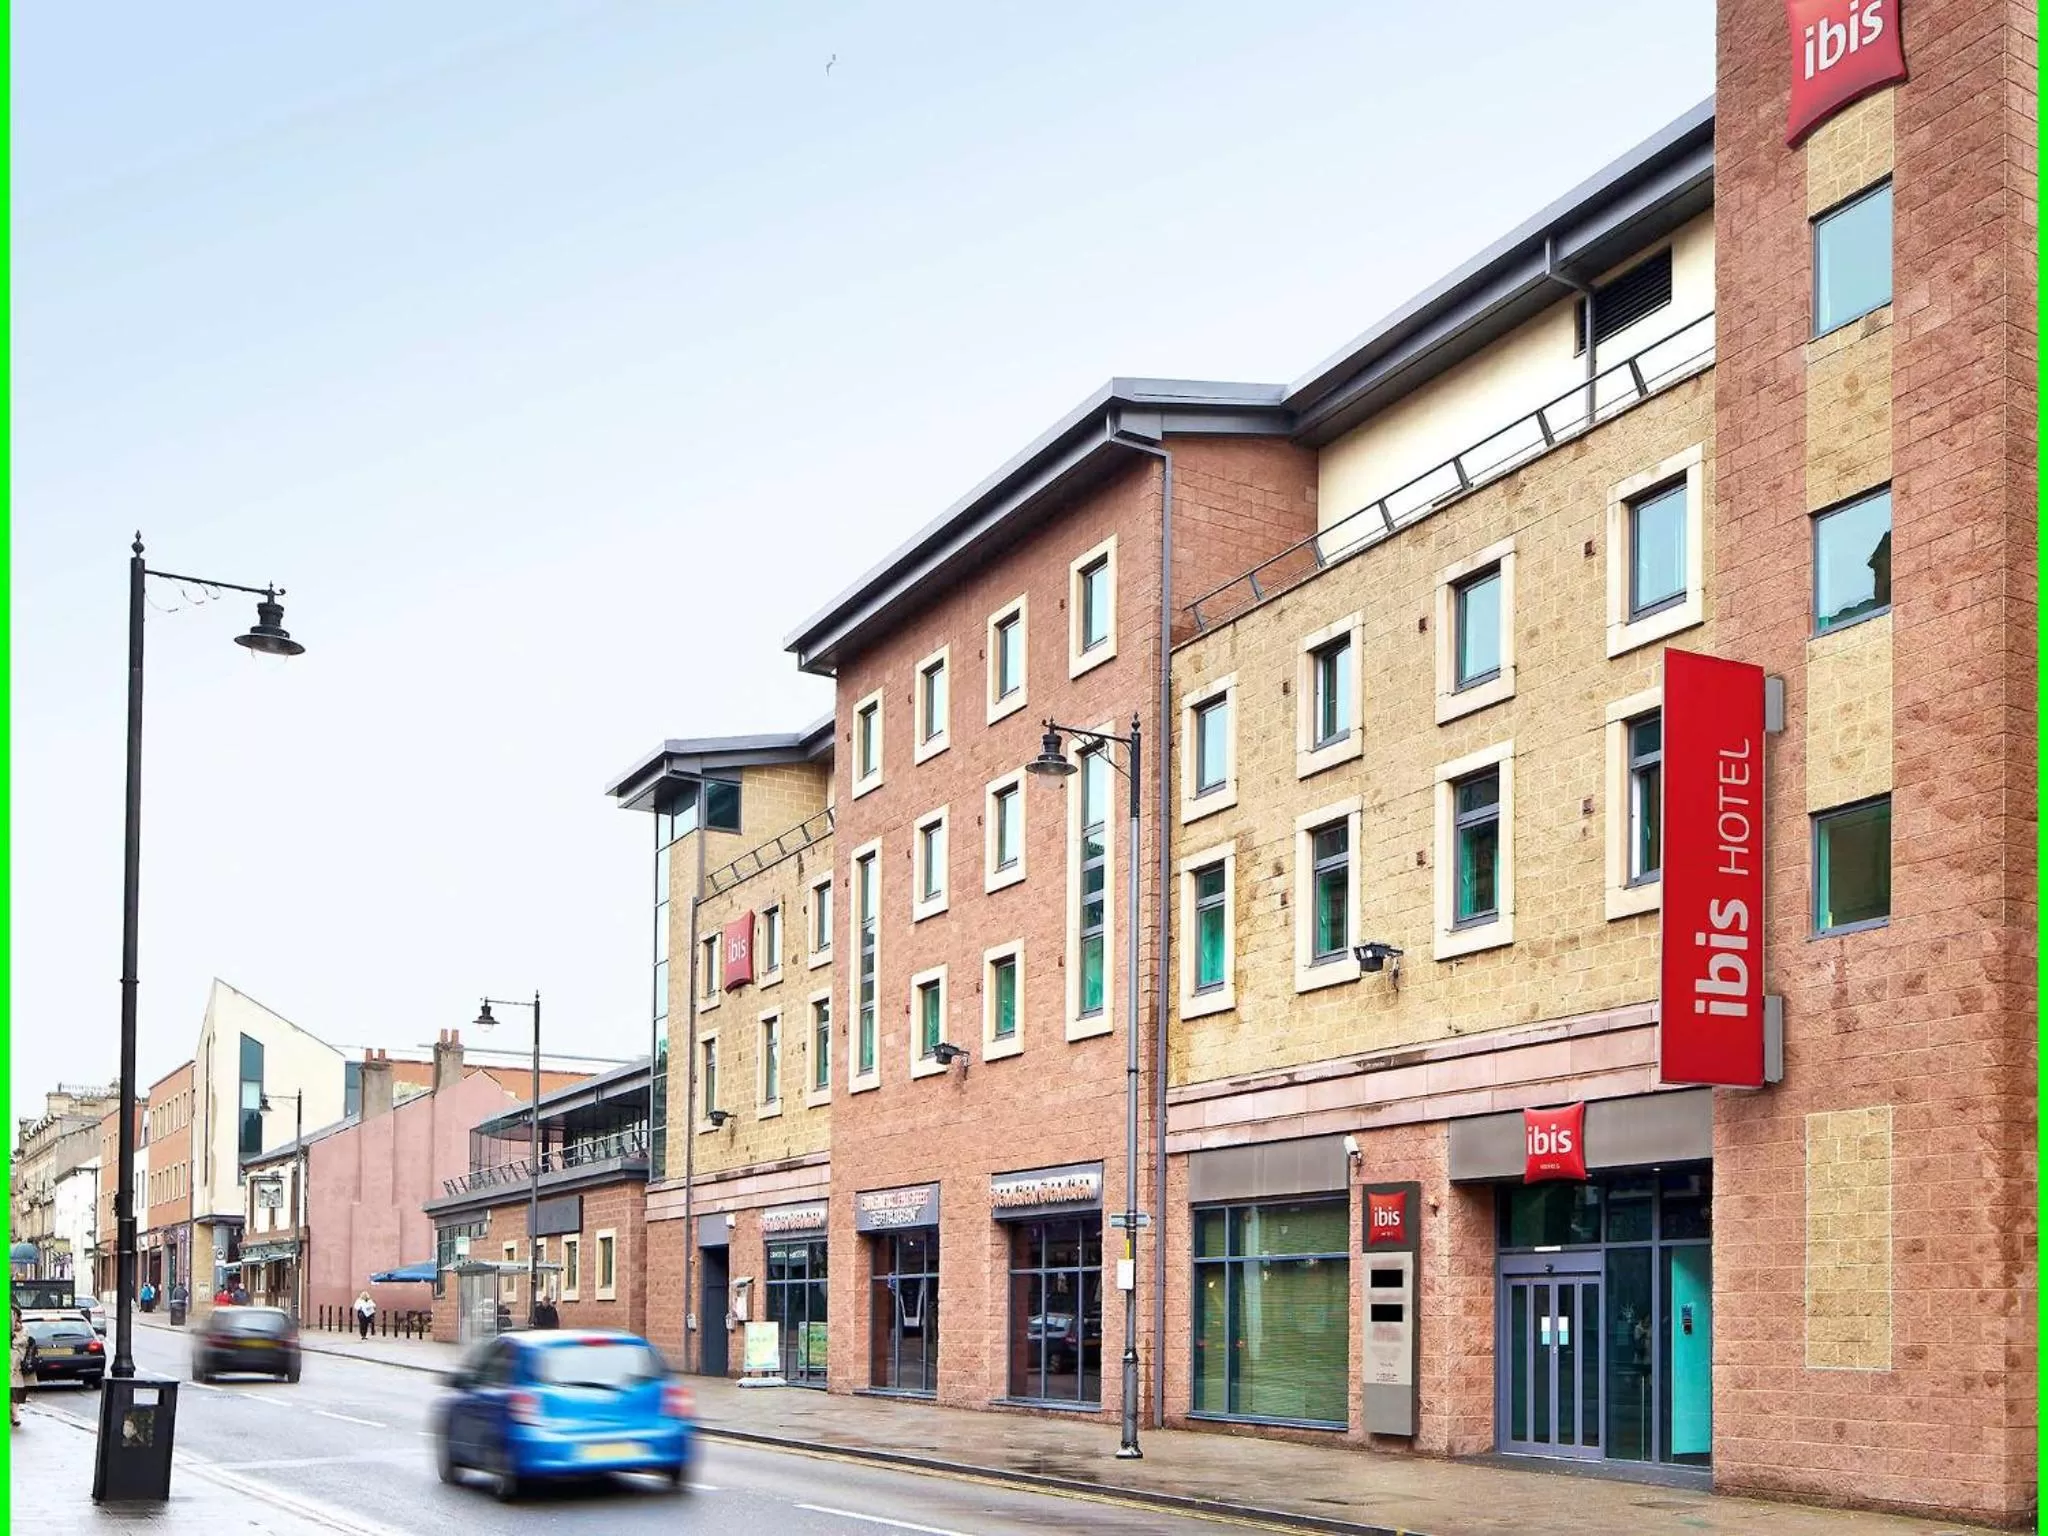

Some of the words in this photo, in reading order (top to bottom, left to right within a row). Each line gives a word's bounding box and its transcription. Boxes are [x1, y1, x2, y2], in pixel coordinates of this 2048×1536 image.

[1804, 0, 1884, 81] ibis
[1718, 738, 1750, 876] HOTEL
[728, 935, 746, 964] ibis
[1695, 899, 1748, 1017] ibis
[1527, 1123, 1573, 1156] ibis
[1374, 1206, 1401, 1227] ibis
